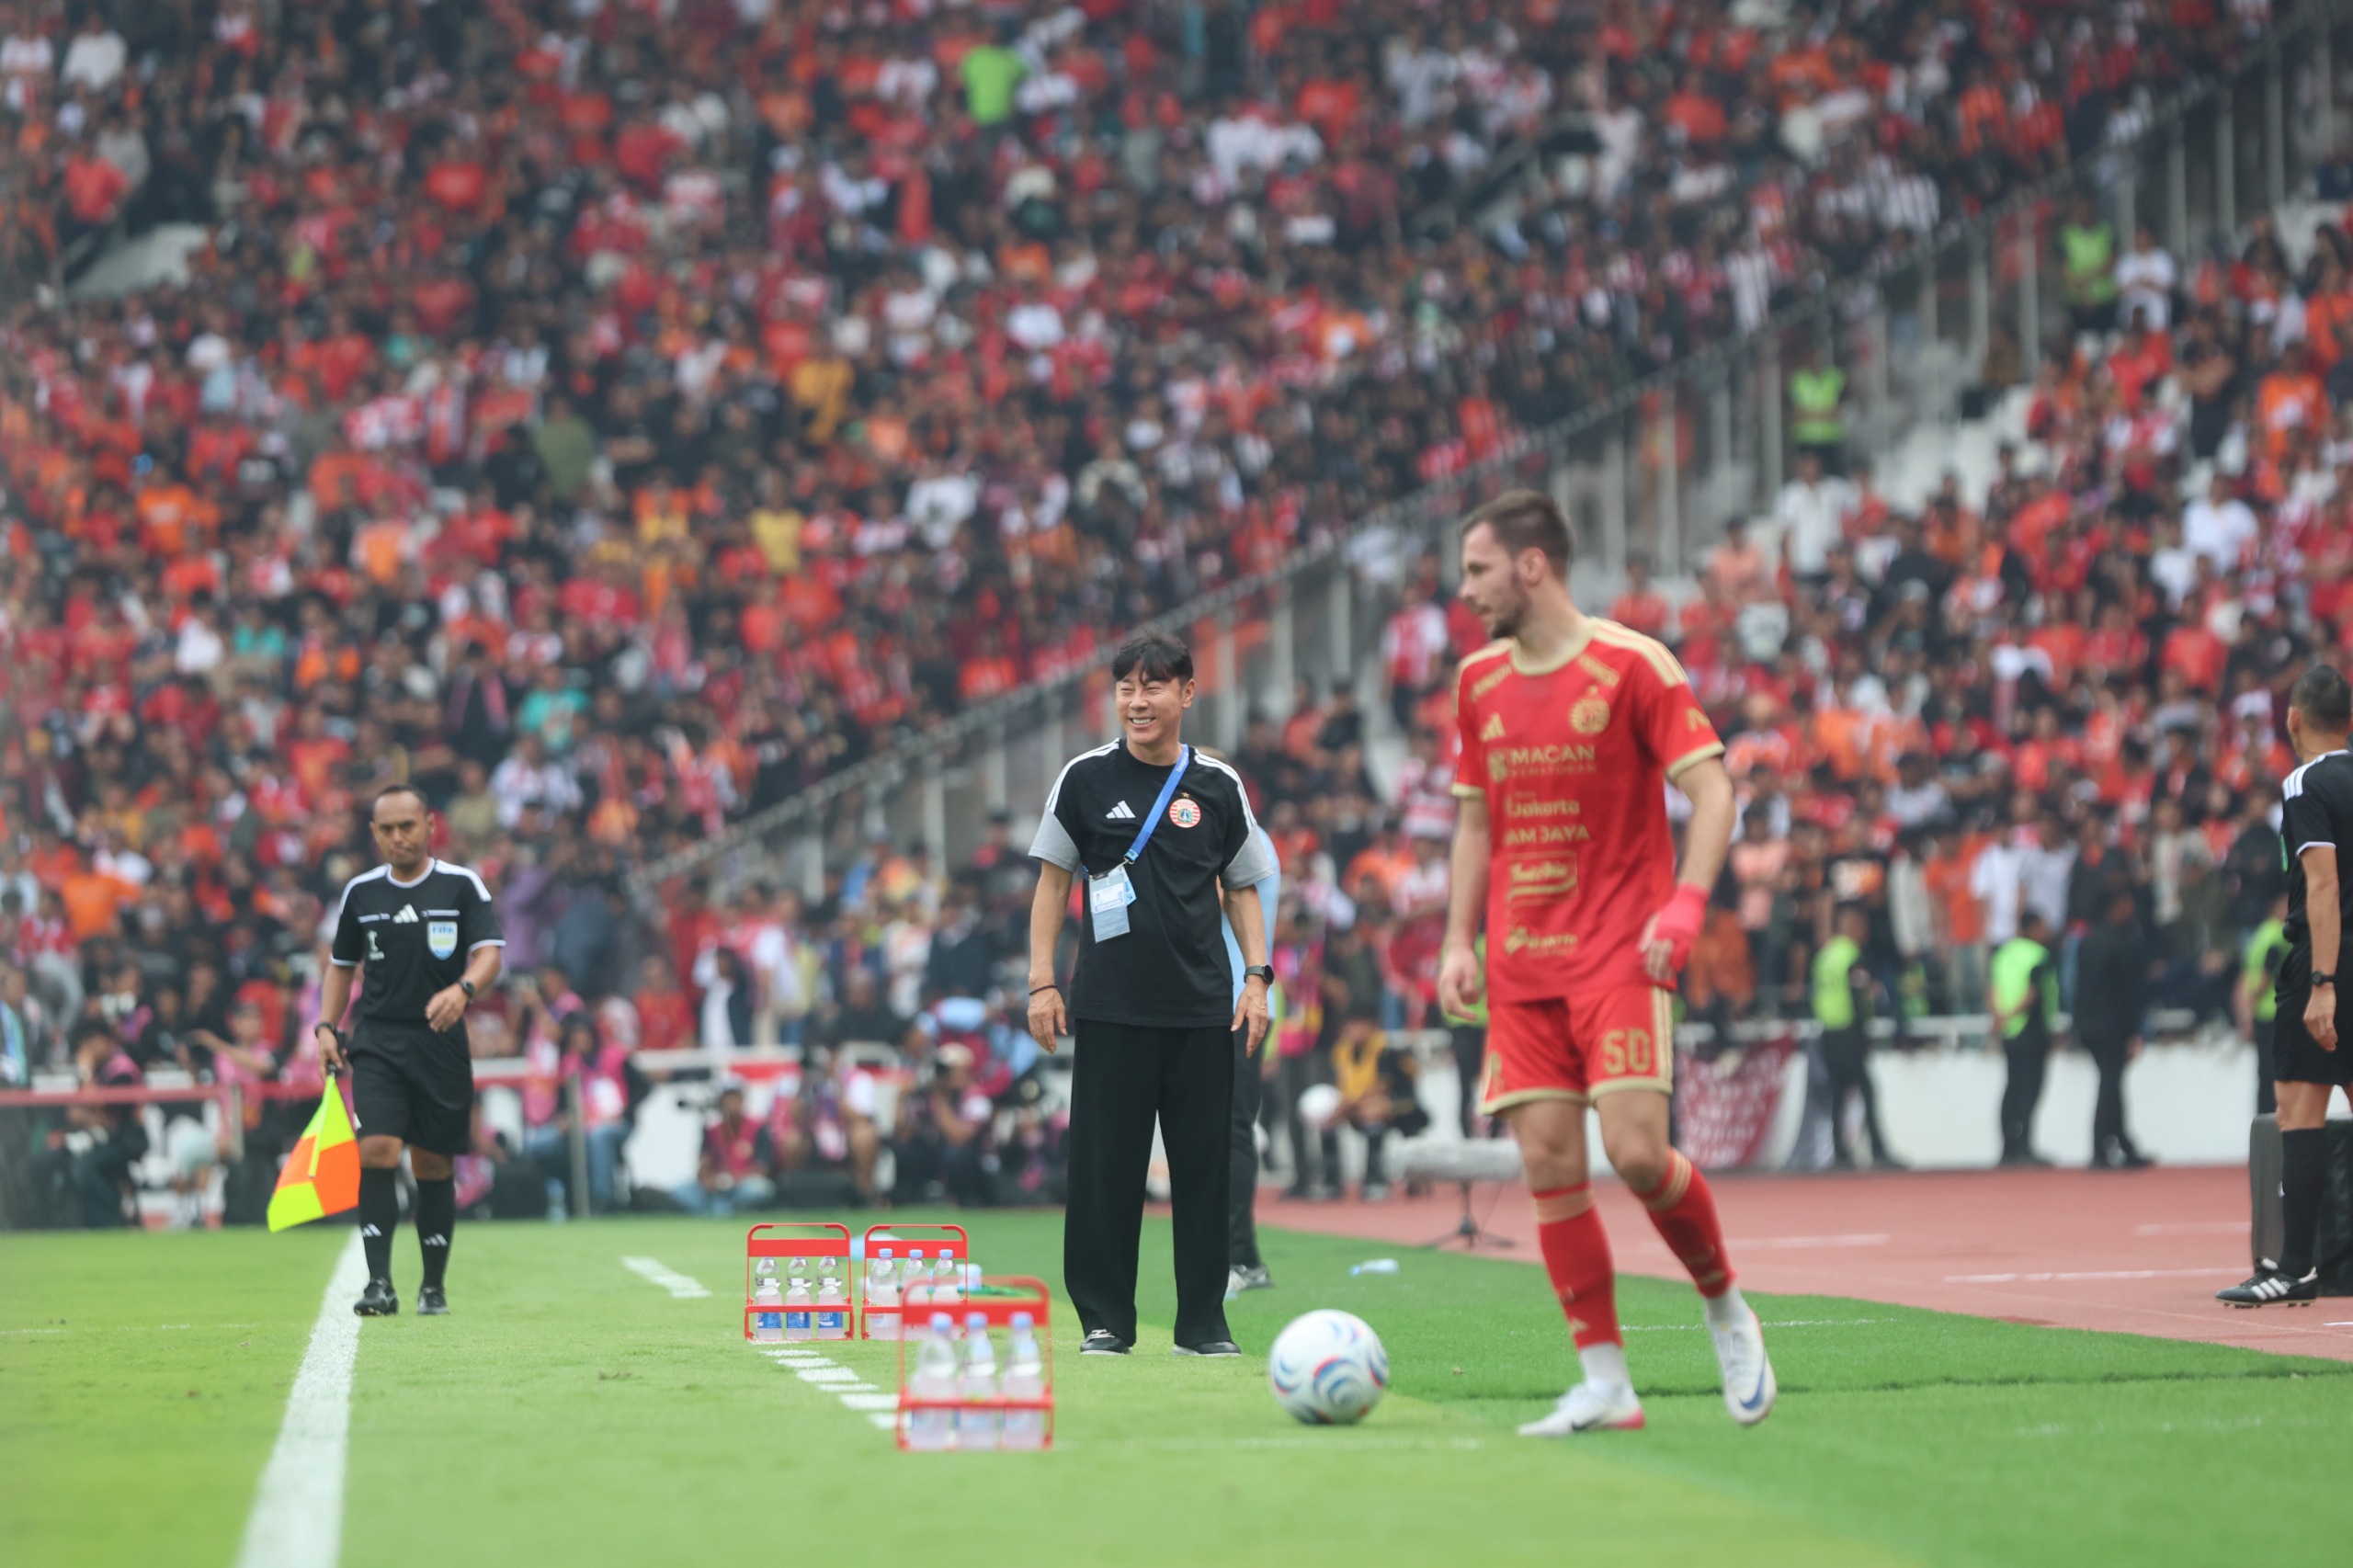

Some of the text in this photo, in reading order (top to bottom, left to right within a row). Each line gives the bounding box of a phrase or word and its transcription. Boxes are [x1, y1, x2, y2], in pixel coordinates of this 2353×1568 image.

[1510, 744, 1596, 765] MACAN
[1513, 798, 1580, 817] Jakarta
[1540, 824, 1590, 843] JAYA
[1602, 1027, 1652, 1074] 50
